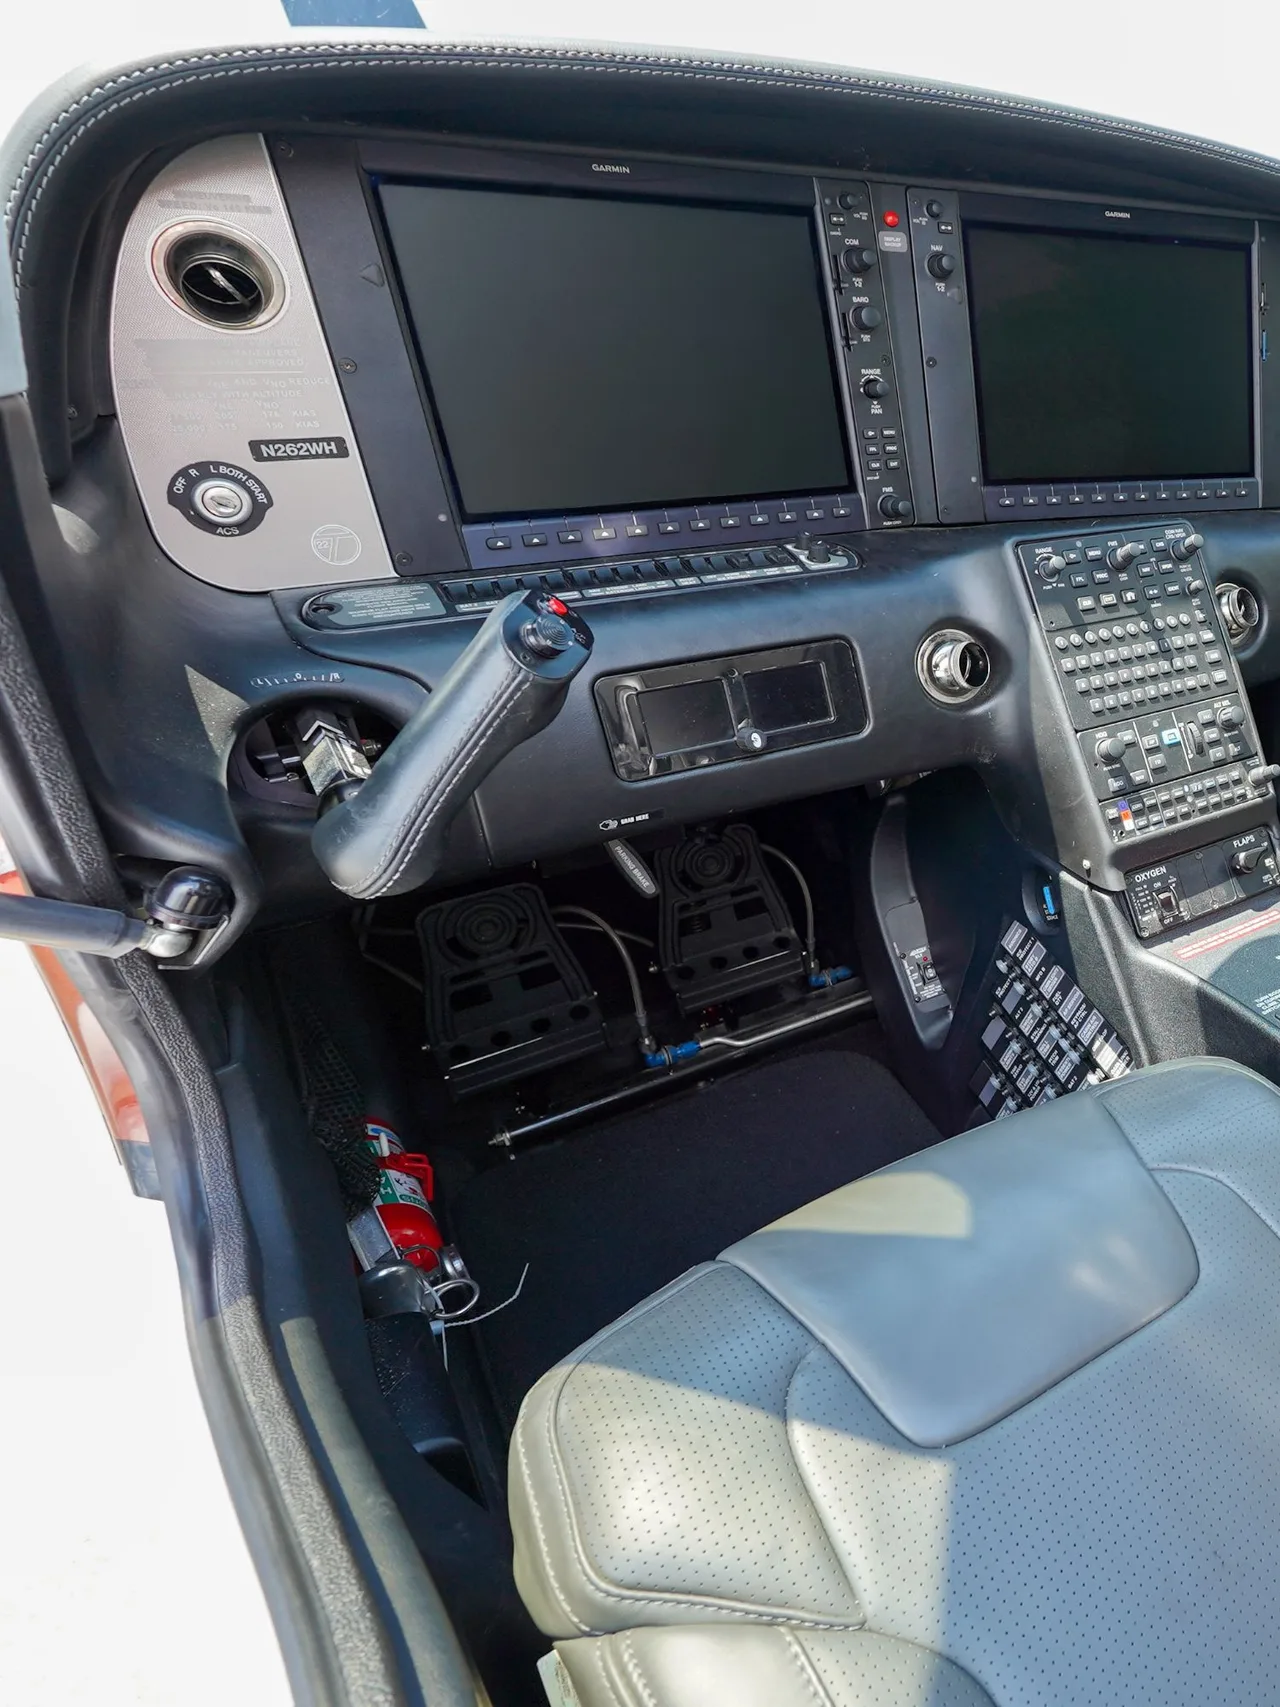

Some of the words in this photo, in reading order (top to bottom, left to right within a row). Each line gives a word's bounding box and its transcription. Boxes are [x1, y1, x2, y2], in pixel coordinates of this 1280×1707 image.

[592, 163, 630, 174] GARMIN
[844, 238, 860, 246] COM
[861, 368, 881, 376] RANGE
[260, 441, 338, 458] N262WH
[173, 476, 187, 495] OFF
[188, 468, 200, 478] R
[209, 464, 218, 474] L
[219, 465, 247, 482] BOTH
[245, 479, 268, 505] START
[216, 526, 240, 536] ACS
[1034, 546, 1053, 554] RANGE
[1233, 834, 1256, 848] FLAPS
[614, 845, 635, 870] PARKING
[632, 868, 650, 888] BRAKE
[1134, 865, 1167, 883] OXYGEN
[1163, 917, 1174, 925] OFF
